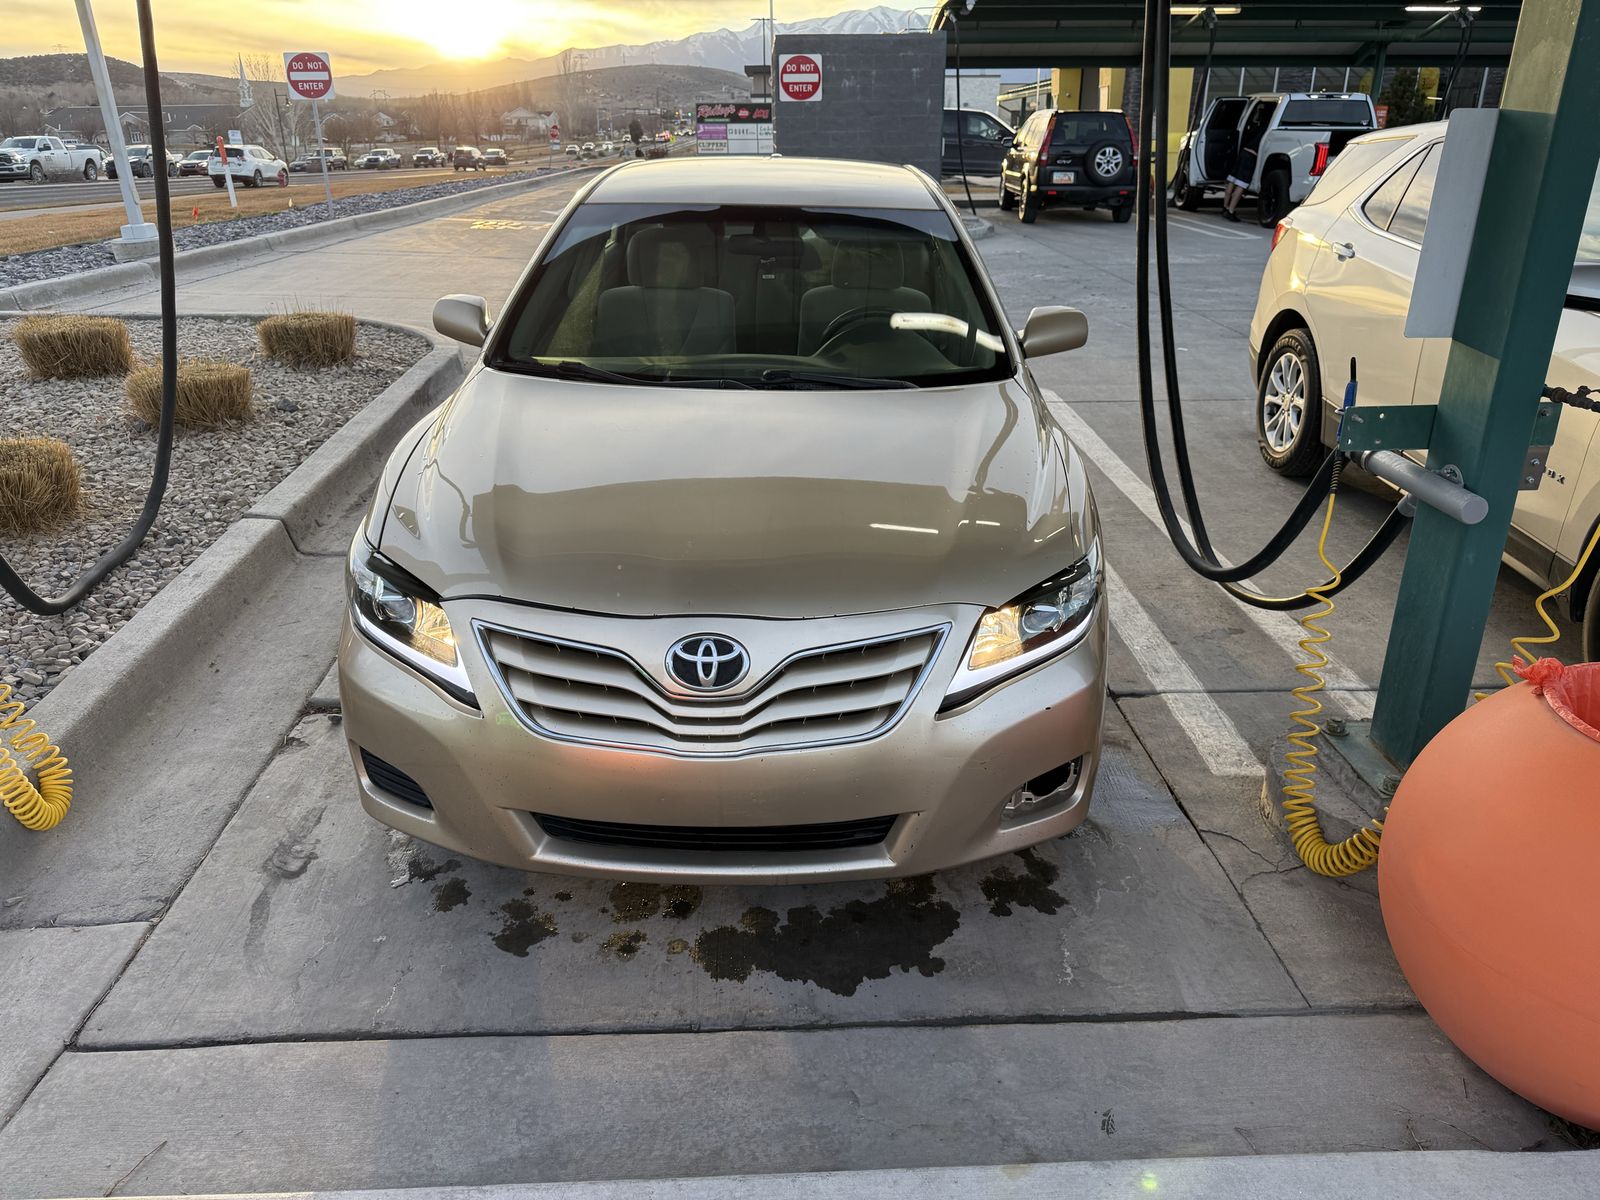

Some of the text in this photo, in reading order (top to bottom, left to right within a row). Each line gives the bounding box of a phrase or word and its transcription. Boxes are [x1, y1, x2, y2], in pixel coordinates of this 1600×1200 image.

[292, 61, 323, 70] DO NOT
[786, 63, 815, 72] DO NOT
[298, 82, 324, 91] ENTER
[788, 84, 812, 92] ENTER
